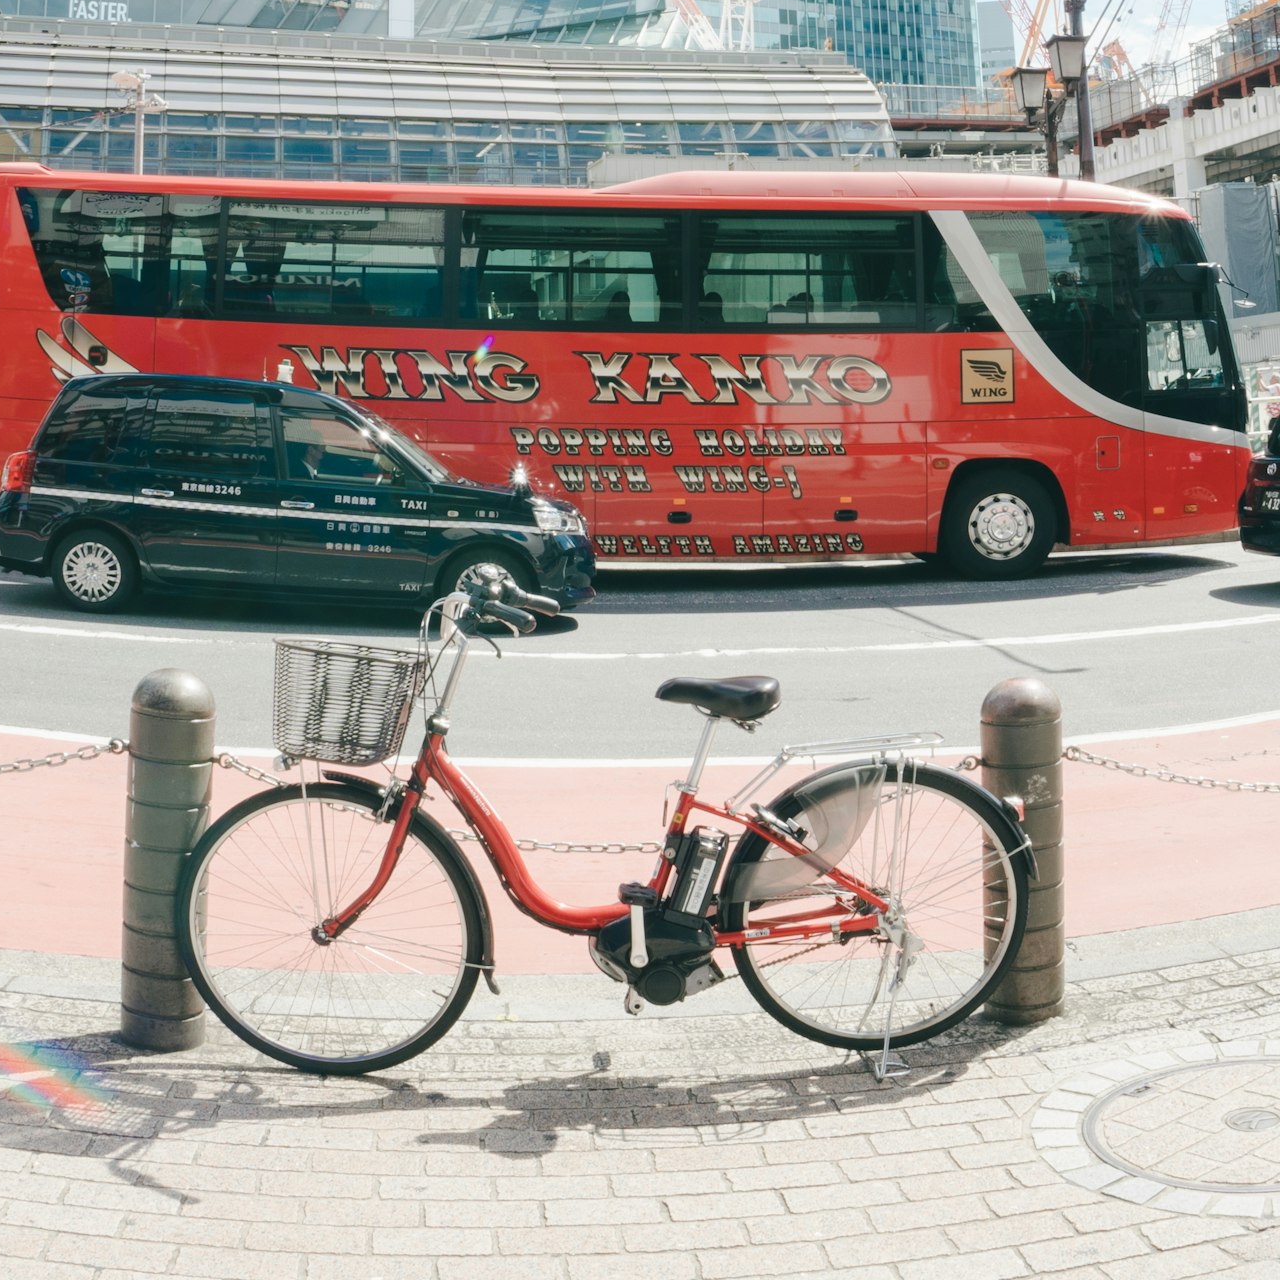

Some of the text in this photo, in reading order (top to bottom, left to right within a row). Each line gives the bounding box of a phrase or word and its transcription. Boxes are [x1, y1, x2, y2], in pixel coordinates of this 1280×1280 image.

[69, 0, 132, 23] FASTER.
[277, 343, 895, 406] WING KANKO
[970, 387, 1008, 398] WING
[509, 427, 847, 457] POPPING HOLIDAY
[552, 464, 802, 499] WITH WING-J
[400, 498, 427, 511] TAXI
[367, 544, 392, 554] 3246
[732, 533, 865, 555] AMAZING
[399, 583, 420, 592] TAXI
